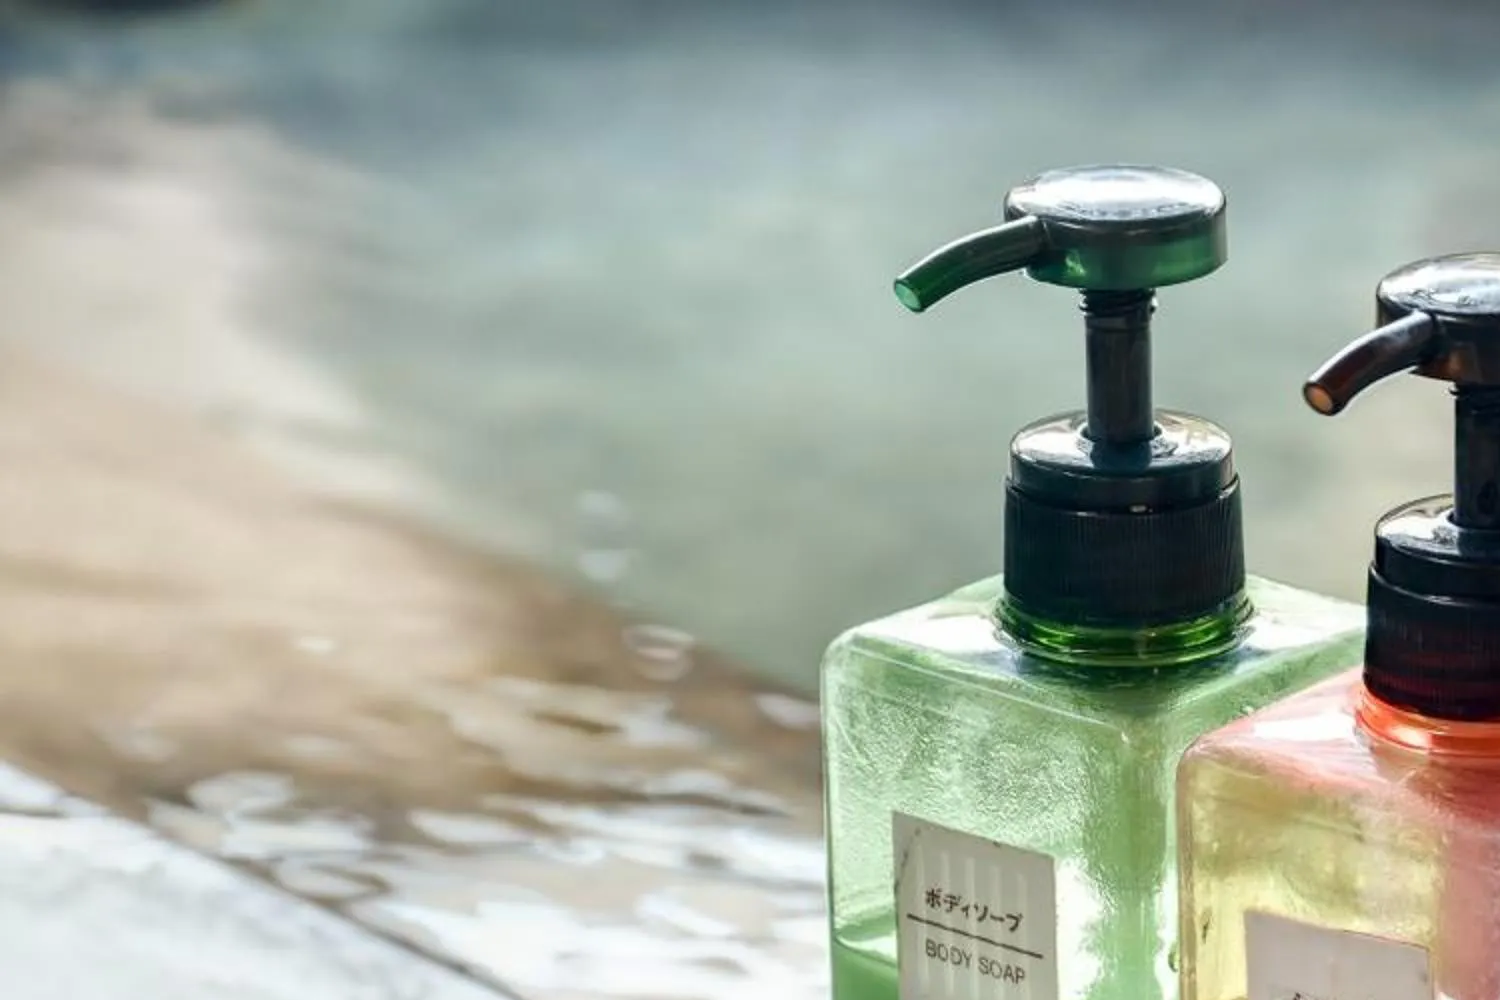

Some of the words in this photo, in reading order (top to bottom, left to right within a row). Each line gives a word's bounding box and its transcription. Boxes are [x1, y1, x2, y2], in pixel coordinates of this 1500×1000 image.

[925, 888, 1023, 932] ボディソープ
[925, 938, 973, 969] BODY
[978, 956, 1026, 985] SOAP
